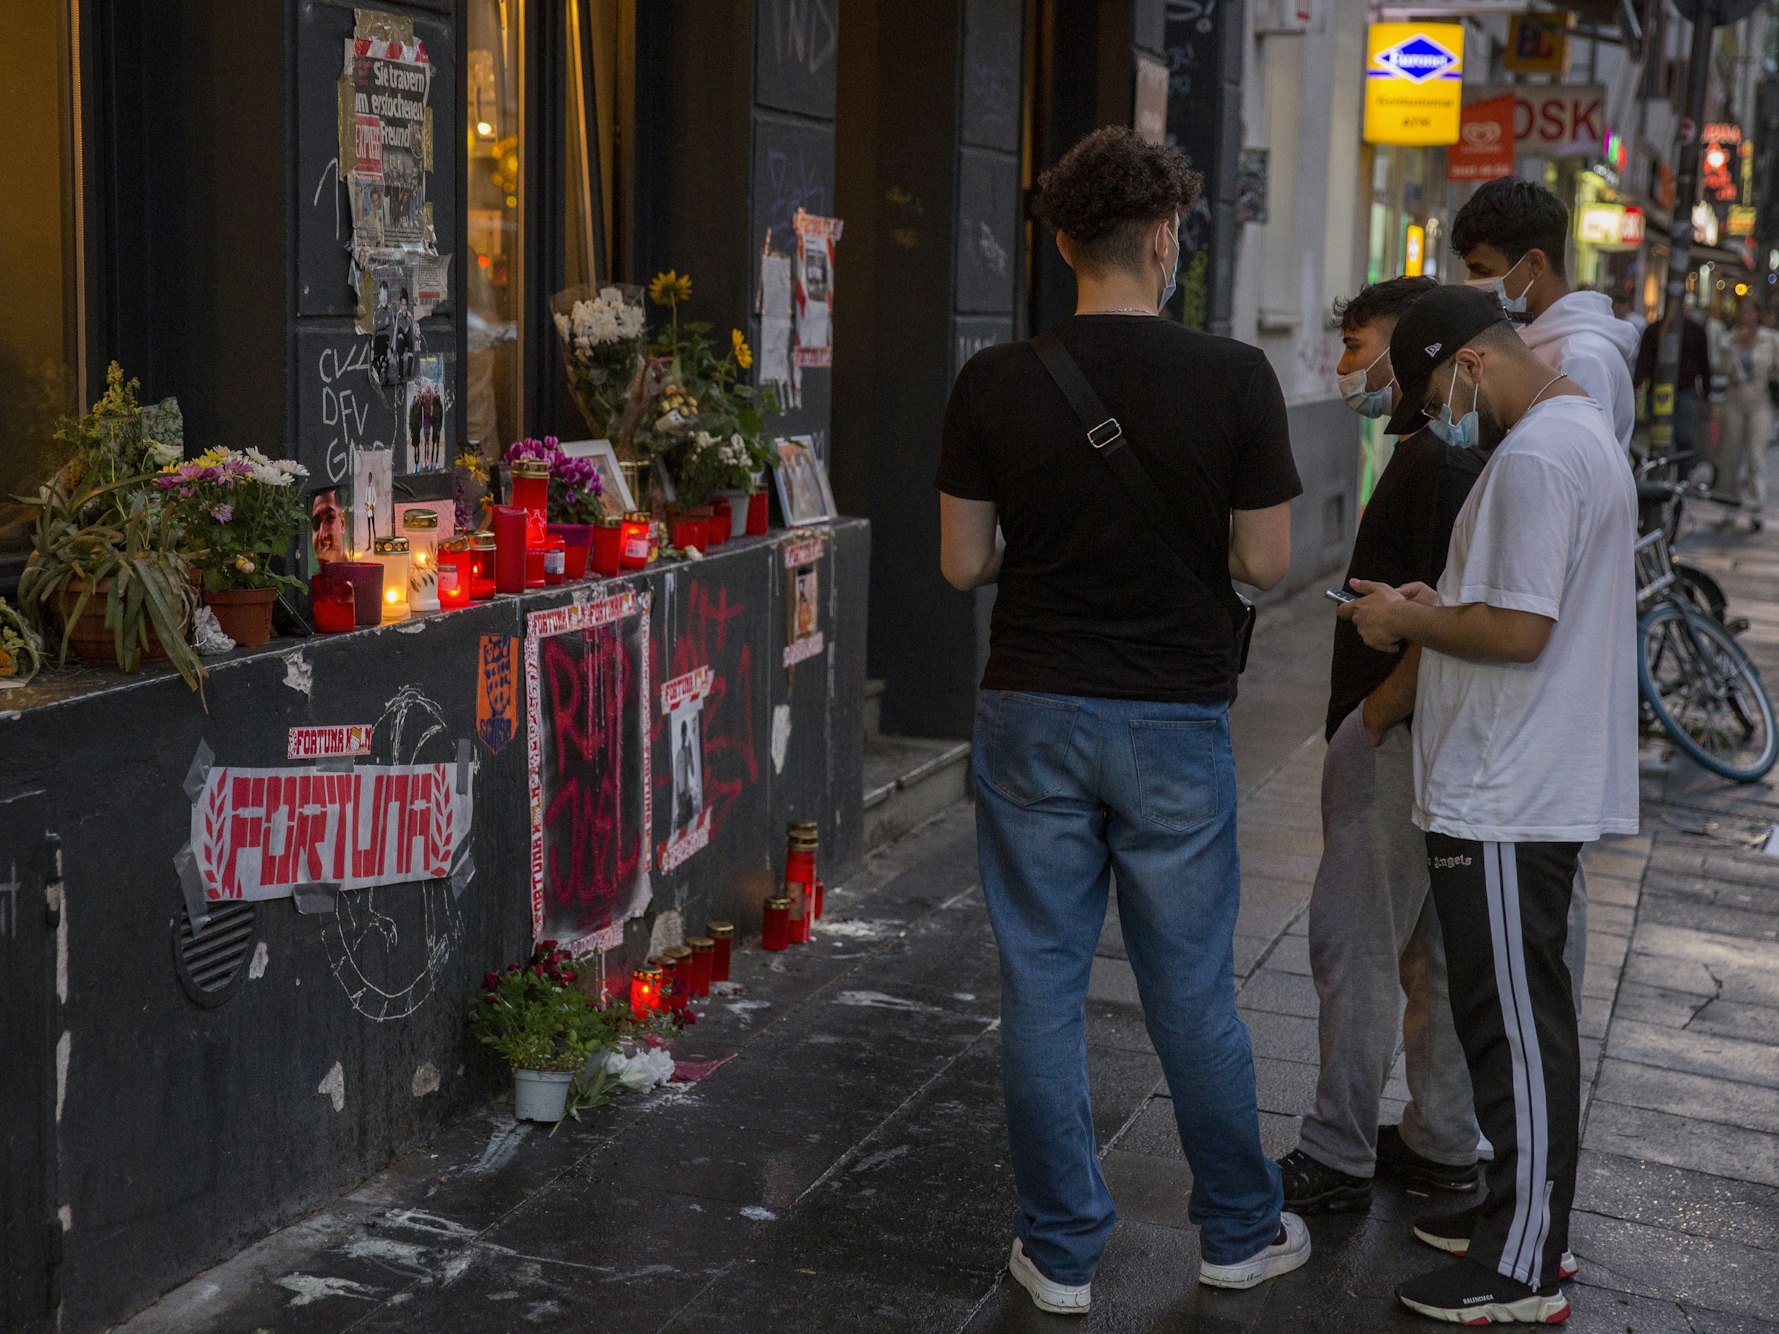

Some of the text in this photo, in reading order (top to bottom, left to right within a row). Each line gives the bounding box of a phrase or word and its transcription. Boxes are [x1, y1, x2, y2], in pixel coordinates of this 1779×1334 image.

[379, 120, 411, 148] Freund
[296, 728, 344, 755] FORTUNA
[221, 772, 433, 899] FORTUNA
